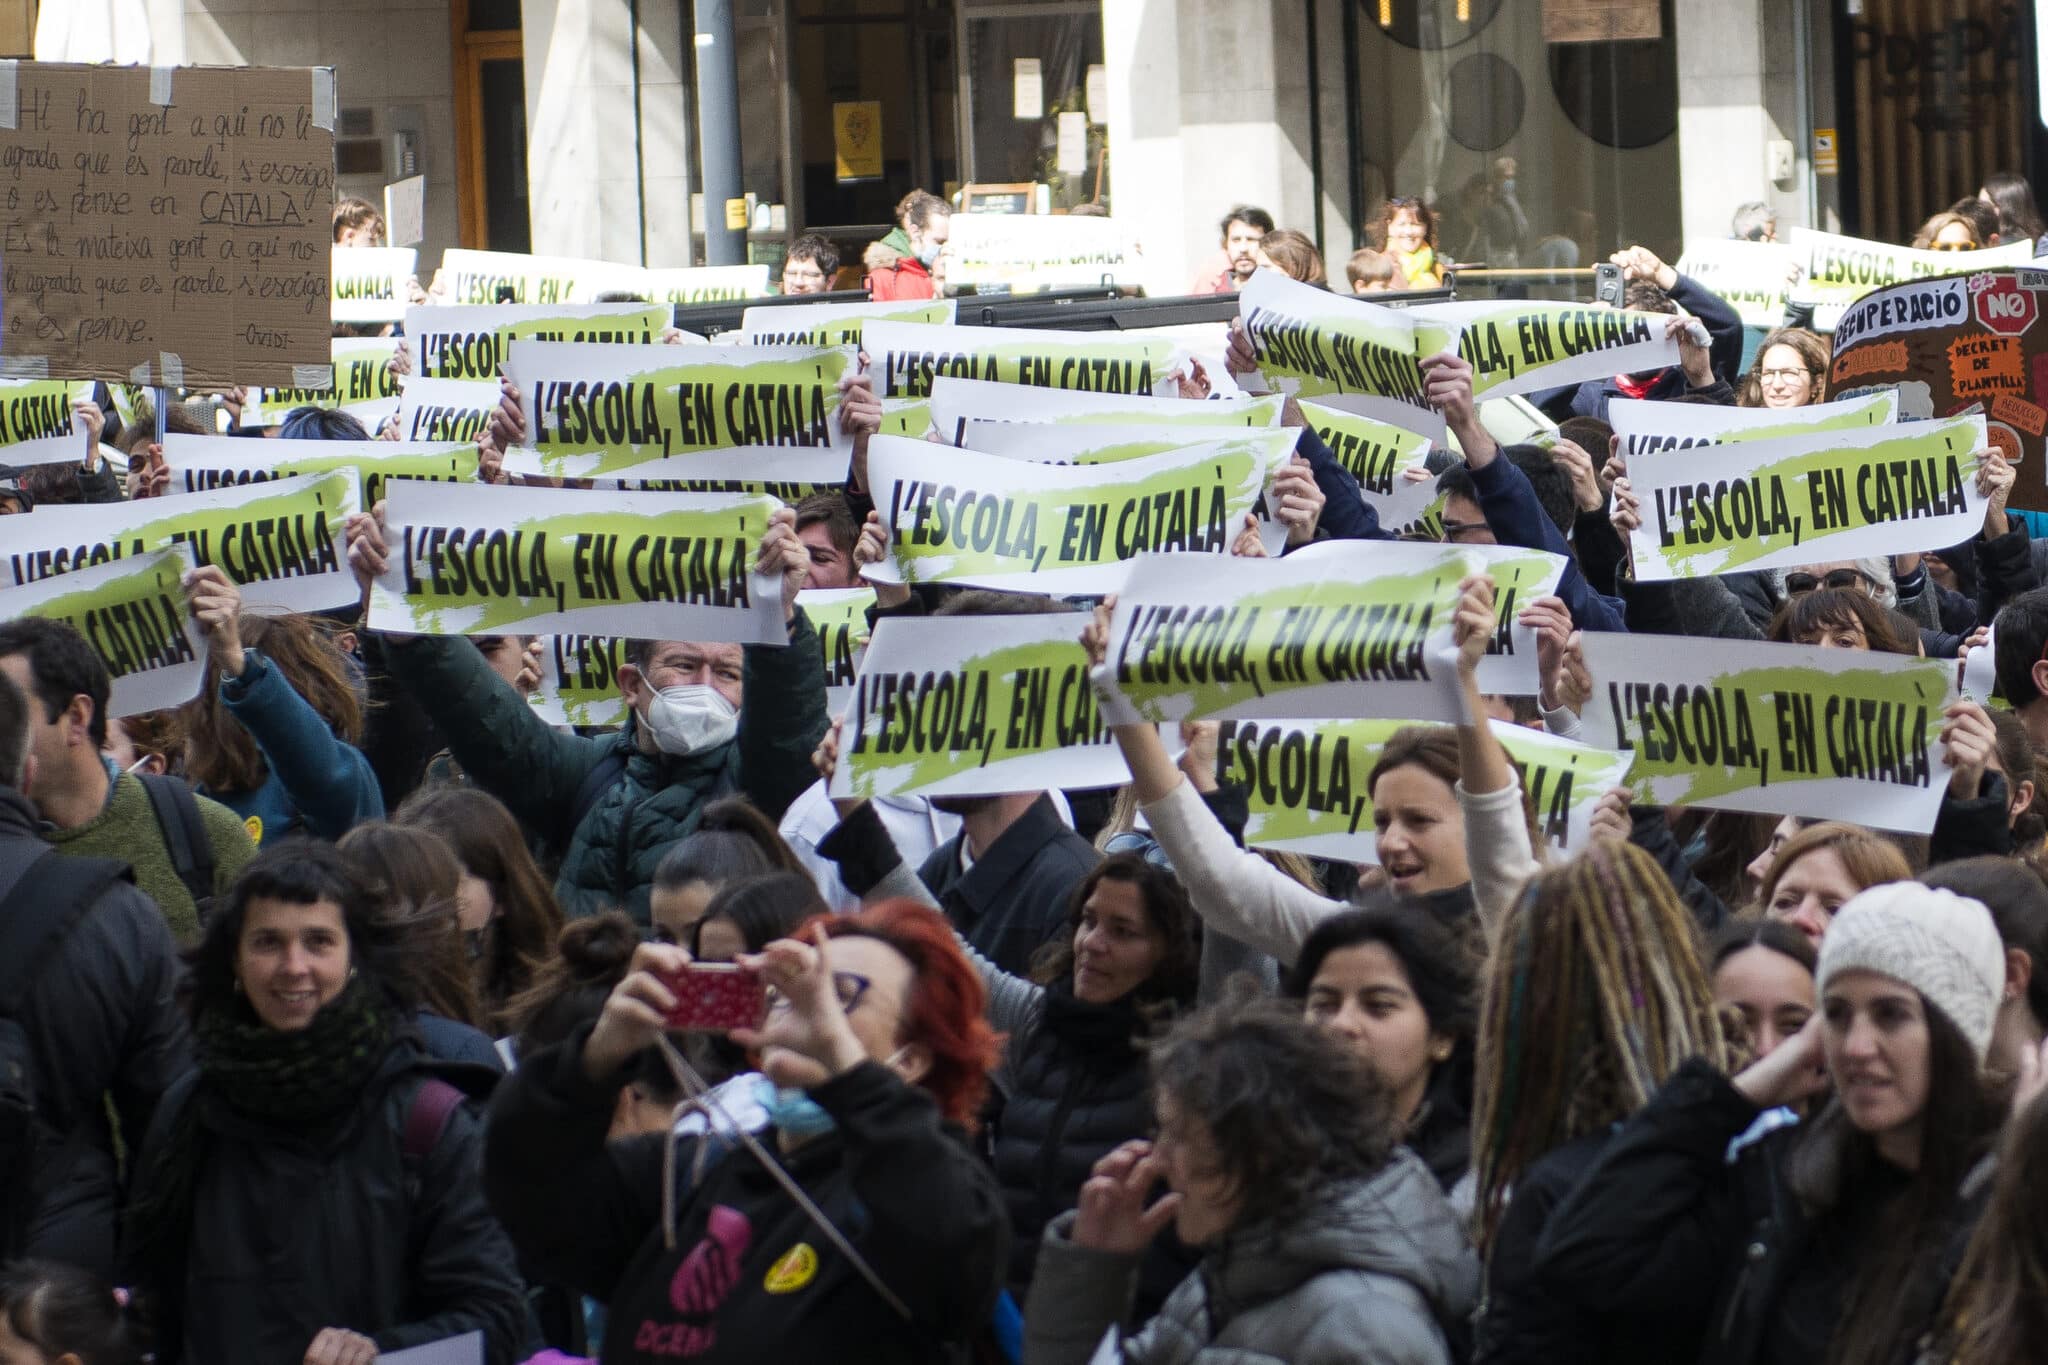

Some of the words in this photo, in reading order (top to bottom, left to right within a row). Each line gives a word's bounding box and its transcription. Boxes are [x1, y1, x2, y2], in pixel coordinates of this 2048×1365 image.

[18, 88, 51, 131] Hi
[77, 88, 110, 134] ha
[128, 104, 177, 152] gent
[190, 116, 206, 137] a
[214, 106, 249, 151] qui
[260, 114, 285, 138] no
[296, 105, 312, 140] li
[1, 141, 61, 181] agrada
[74, 152, 110, 192] que
[125, 155, 149, 176] es
[151, 196, 177, 215] en
[75, 224, 153, 260] mateixa
[169, 231, 207, 272] gent
[220, 240, 240, 260] a
[248, 236, 280, 272] qui
[289, 239, 318, 261] no
[95, 277, 129, 310] que
[1987, 292, 2026, 319] NO
[1333, 331, 1370, 392] EN
[1517, 312, 1554, 365] EN
[1973, 357, 1990, 371] DE
[350, 360, 374, 399] EN
[1019, 354, 1050, 389] EN
[1061, 346, 1153, 397] CATALÀ
[534, 380, 671, 459] L'ESCOLA,
[679, 382, 717, 446] EN
[724, 365, 831, 448] CATALÀ
[892, 479, 1048, 573] L'ESCOLA,
[1060, 502, 1109, 562] EN
[1116, 464, 1227, 559] CATALÀ
[1655, 473, 1801, 547] L'ESCOLA,
[1807, 467, 1849, 531] EN
[1856, 436, 1968, 526] CATALÀ
[221, 491, 340, 586] CATALÀ
[403, 525, 565, 613] L'ESCOLA,
[573, 532, 620, 601] EN
[626, 516, 752, 610] CATALÀ
[1116, 604, 1265, 698] L'ESCOLA,
[1269, 605, 1314, 683] EN
[851, 671, 997, 768] L'ESCOLA,
[1005, 667, 1051, 749] EN
[1609, 681, 1769, 788] L'ESCOLA,
[1773, 690, 1819, 775] EN
[1824, 680, 1931, 789] CATALÀ
[1215, 719, 1366, 835] ESCOLA,
